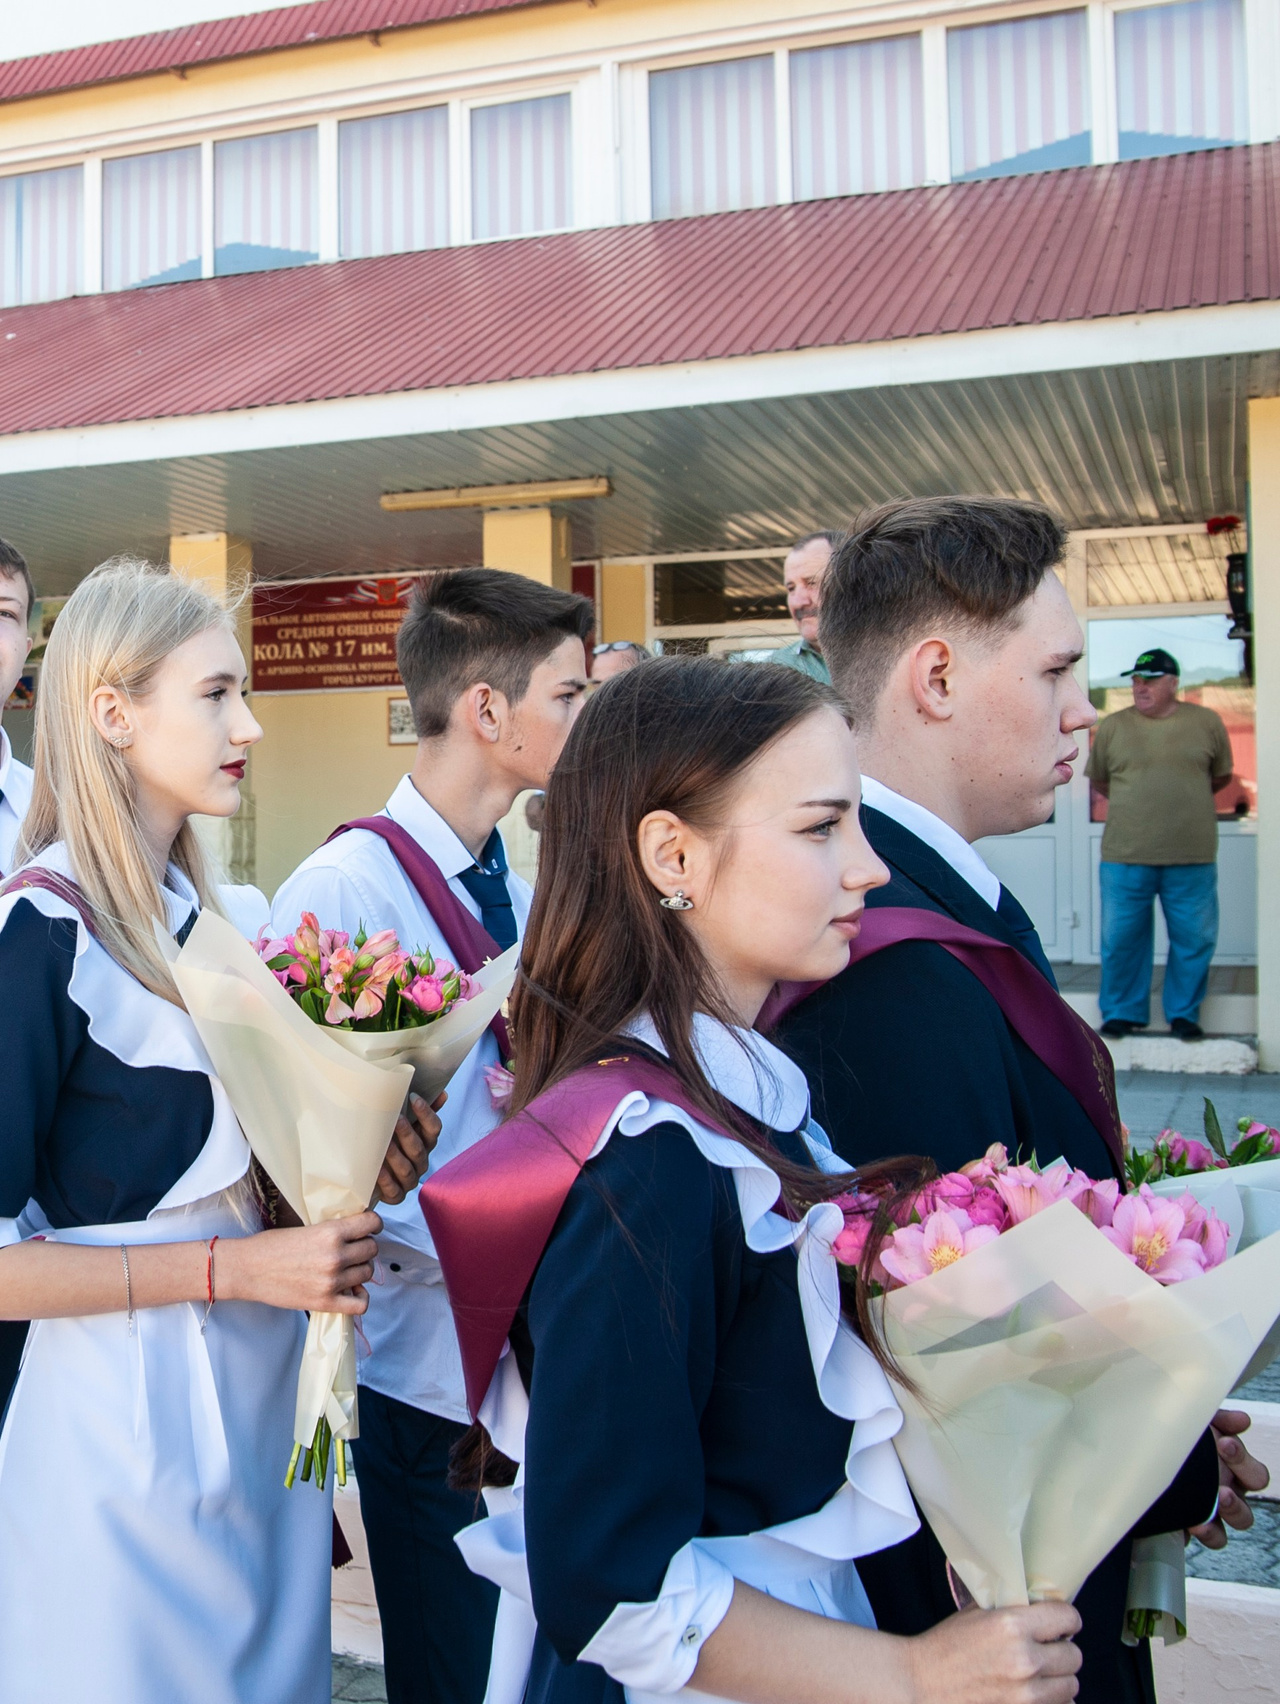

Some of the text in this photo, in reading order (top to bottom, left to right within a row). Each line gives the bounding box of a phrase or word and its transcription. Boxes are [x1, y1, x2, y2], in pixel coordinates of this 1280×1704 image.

[277, 626, 334, 640] СРЕДНЯЯ
[254, 639, 393, 660] КОЛА № 17 им.
